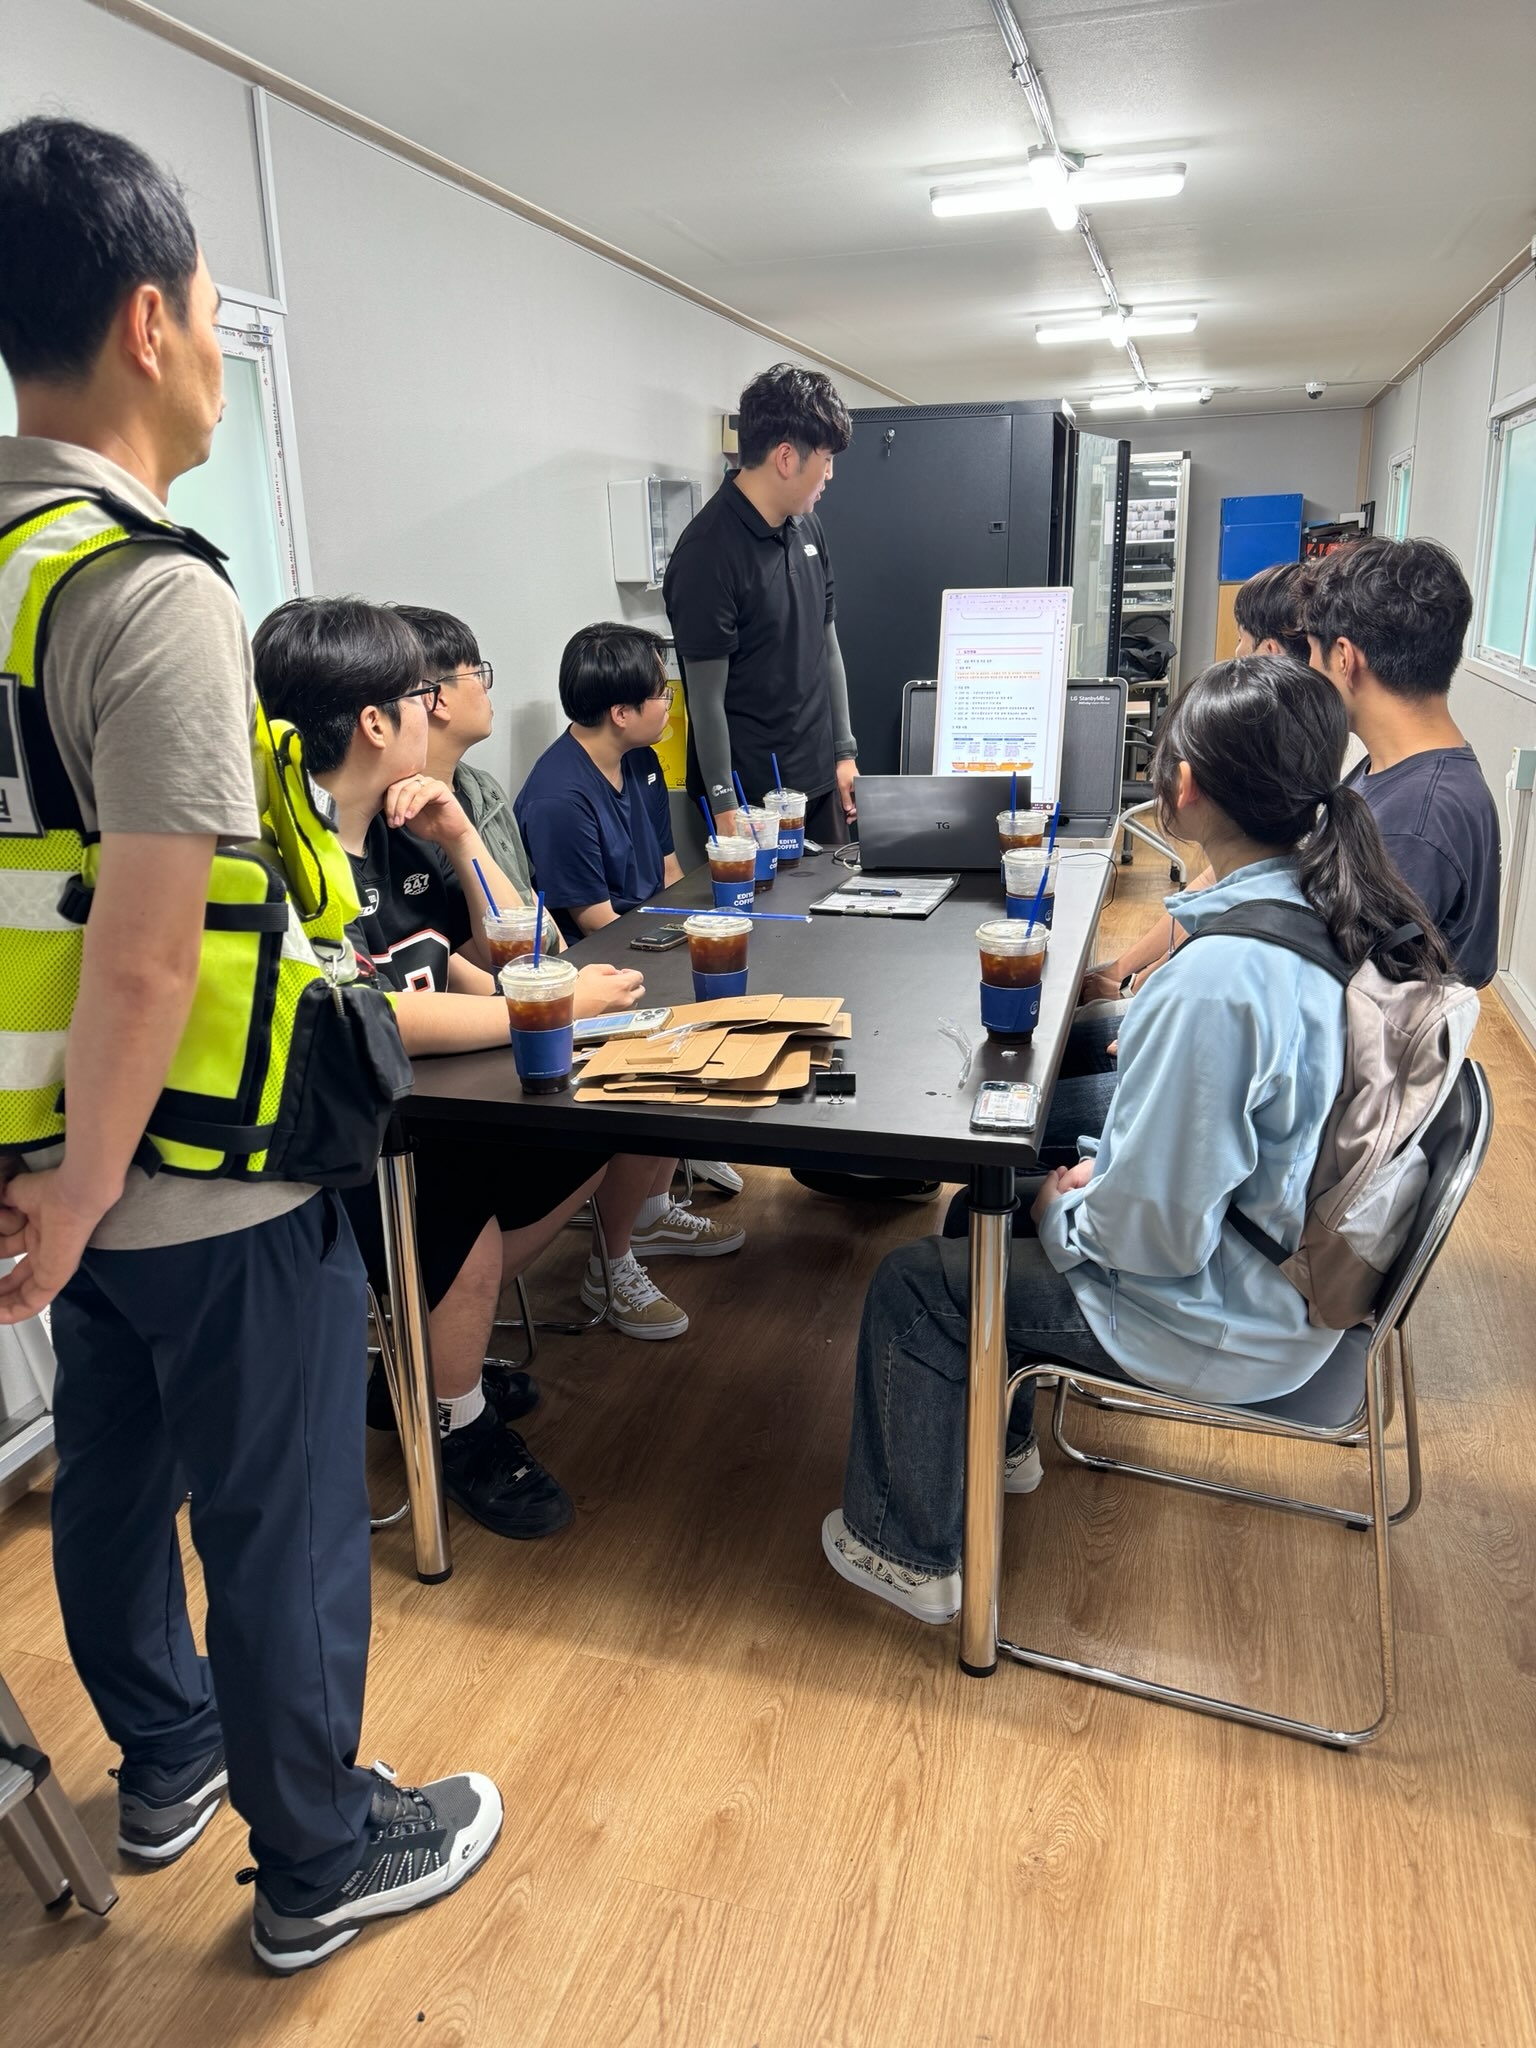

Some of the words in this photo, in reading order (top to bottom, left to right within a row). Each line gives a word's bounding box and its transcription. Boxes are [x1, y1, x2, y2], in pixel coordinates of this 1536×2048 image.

[935, 821, 951, 830] TG
[403, 873, 430, 895] 247
[340, 1870, 364, 1894] NEPA
